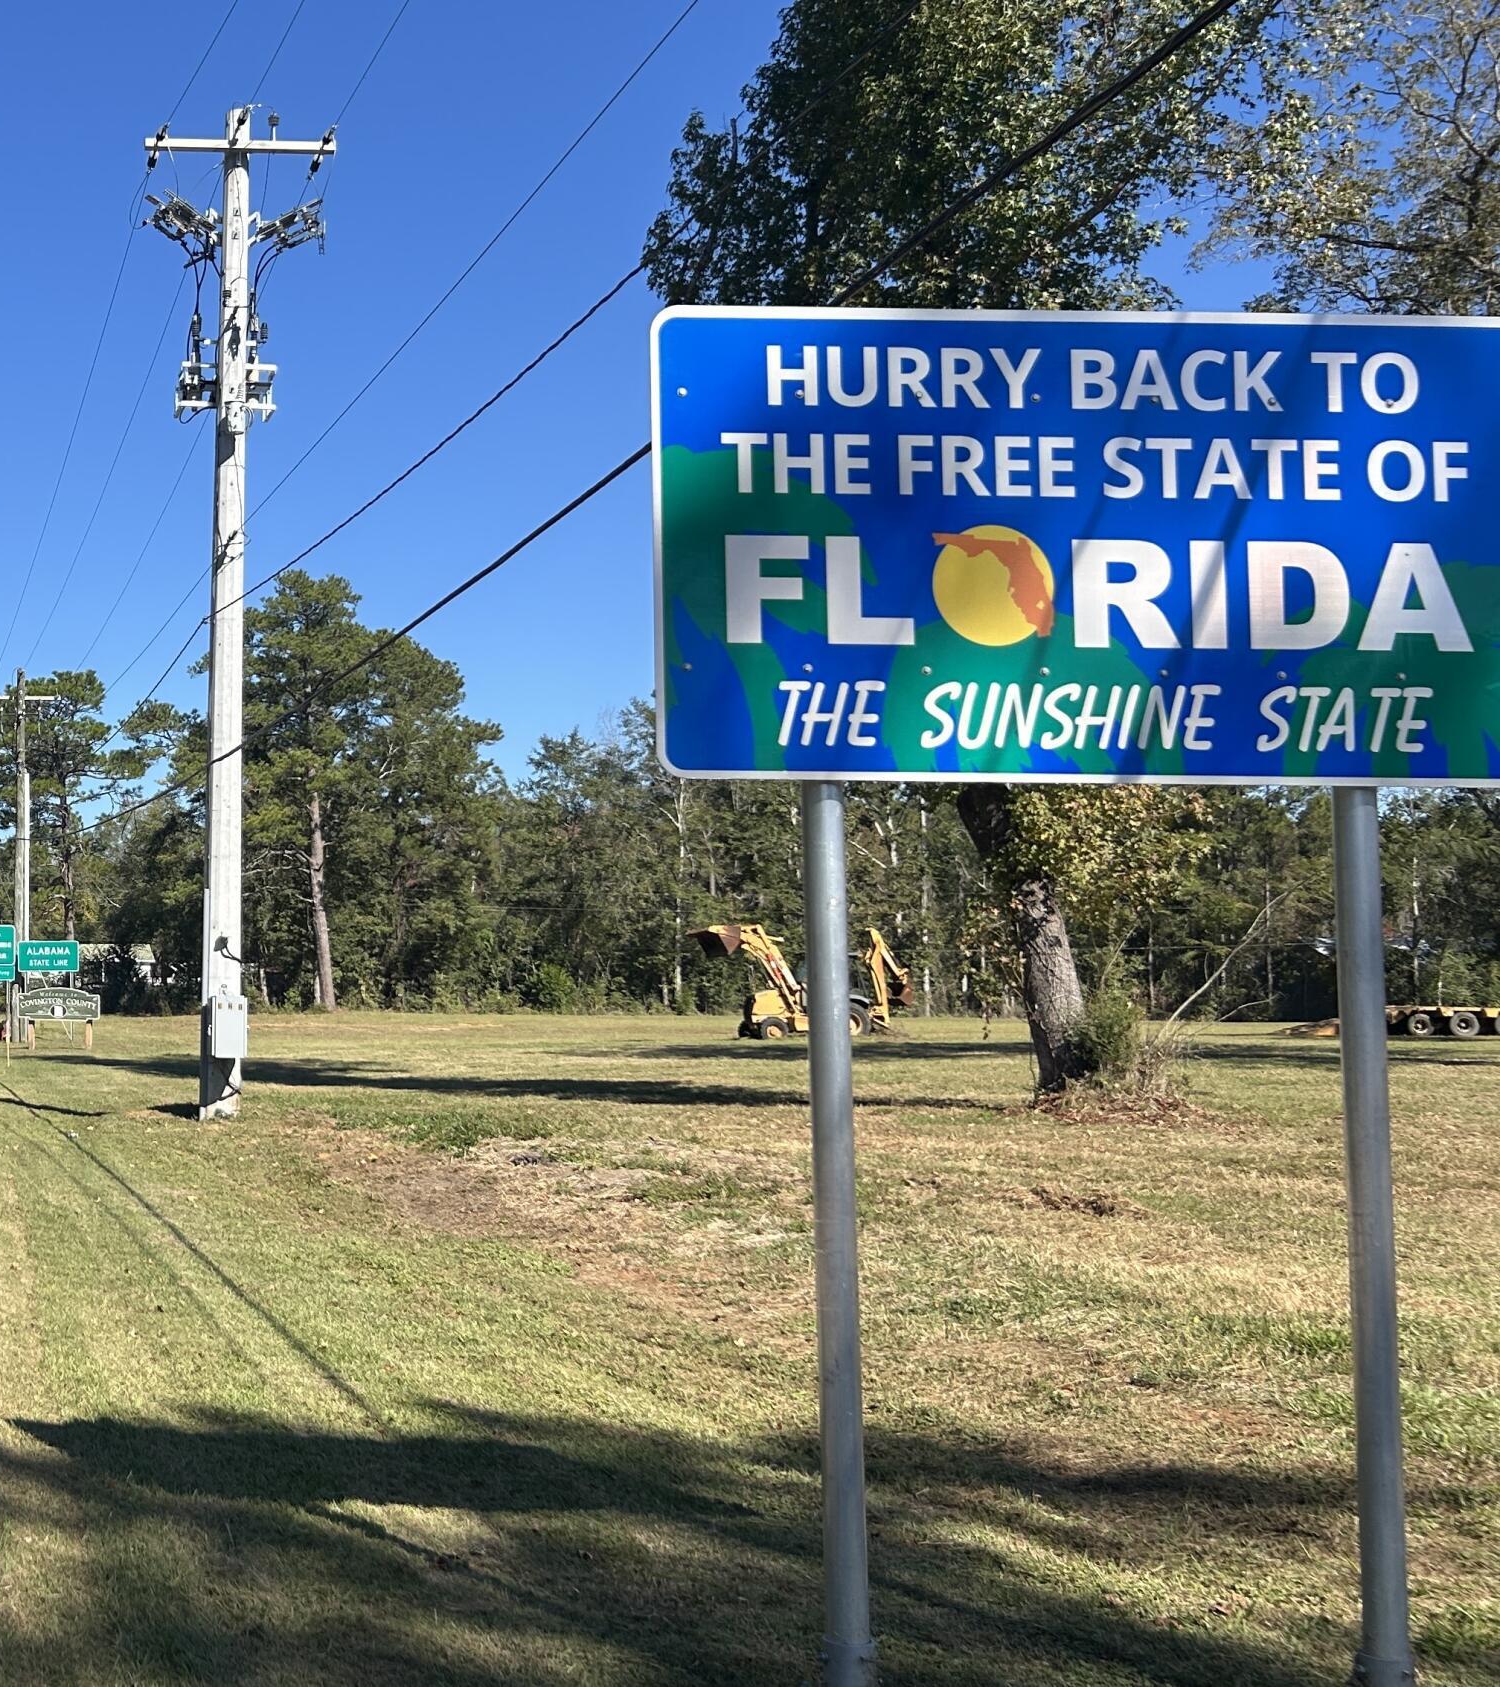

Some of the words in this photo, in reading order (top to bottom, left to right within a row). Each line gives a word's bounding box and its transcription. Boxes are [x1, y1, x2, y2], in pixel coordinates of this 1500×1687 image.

[765, 344, 1041, 409] HURRY
[1069, 349, 1283, 413] BACK
[1310, 351, 1420, 415] TO
[719, 431, 873, 495] THE
[897, 434, 1078, 498] FREE
[1102, 437, 1343, 502] STATE
[1366, 440, 1469, 503] OF
[776, 679, 887, 748] THE
[919, 680, 1222, 752] SUNSHINE
[1255, 684, 1435, 754] STATE
[26, 946, 71, 955] ALABAMA
[29, 959, 50, 967] STATE
[53, 959, 69, 967] LINE
[20, 997, 64, 1009] COVINGTON
[65, 997, 97, 1010] COUNTY
